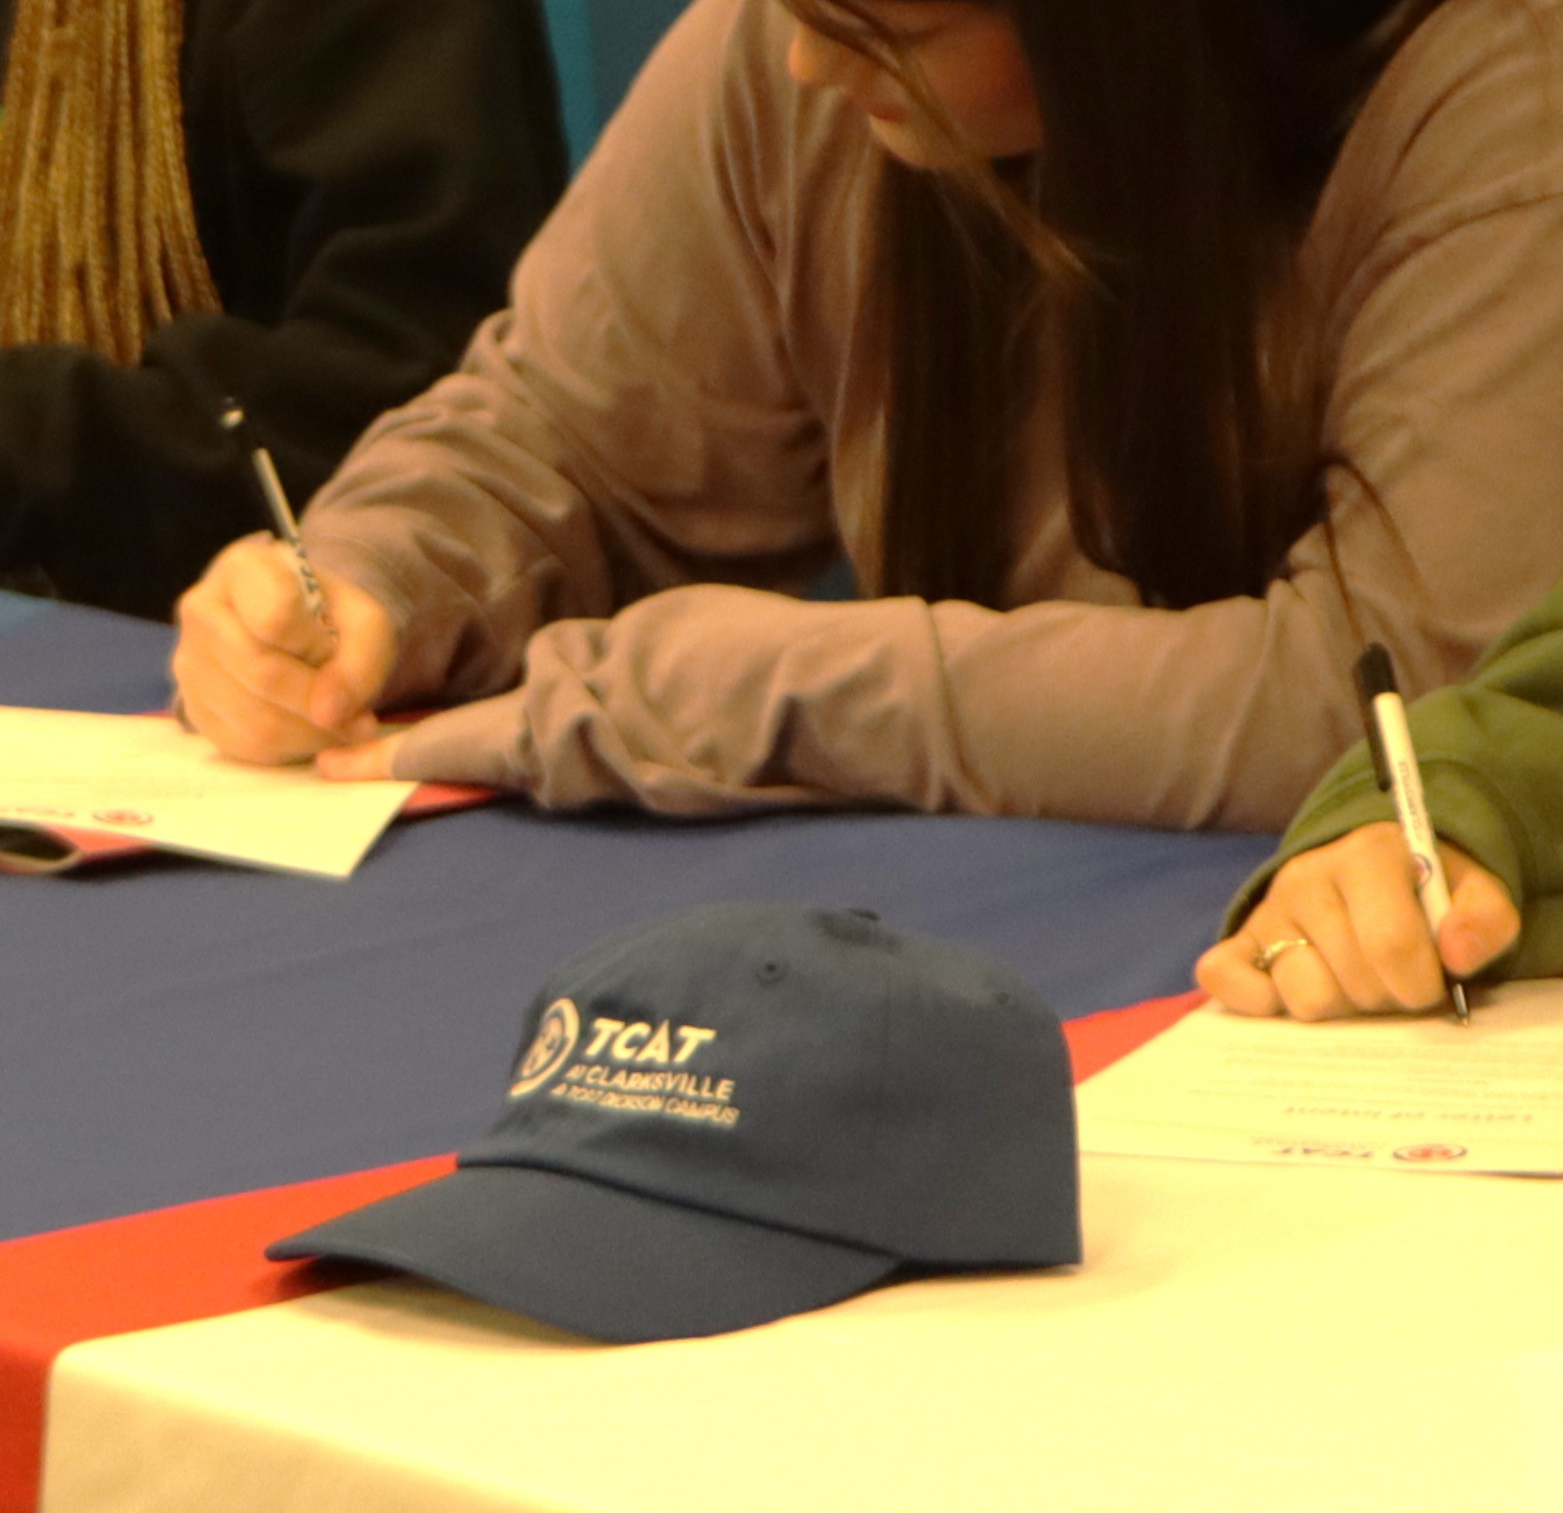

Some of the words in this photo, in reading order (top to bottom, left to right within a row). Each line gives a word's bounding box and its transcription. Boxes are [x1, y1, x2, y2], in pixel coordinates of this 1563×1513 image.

[584, 1017, 718, 1065] TCAT
[585, 1064, 736, 1103] CLARKSVILLE
[664, 1096, 741, 1127] CAMPUS
